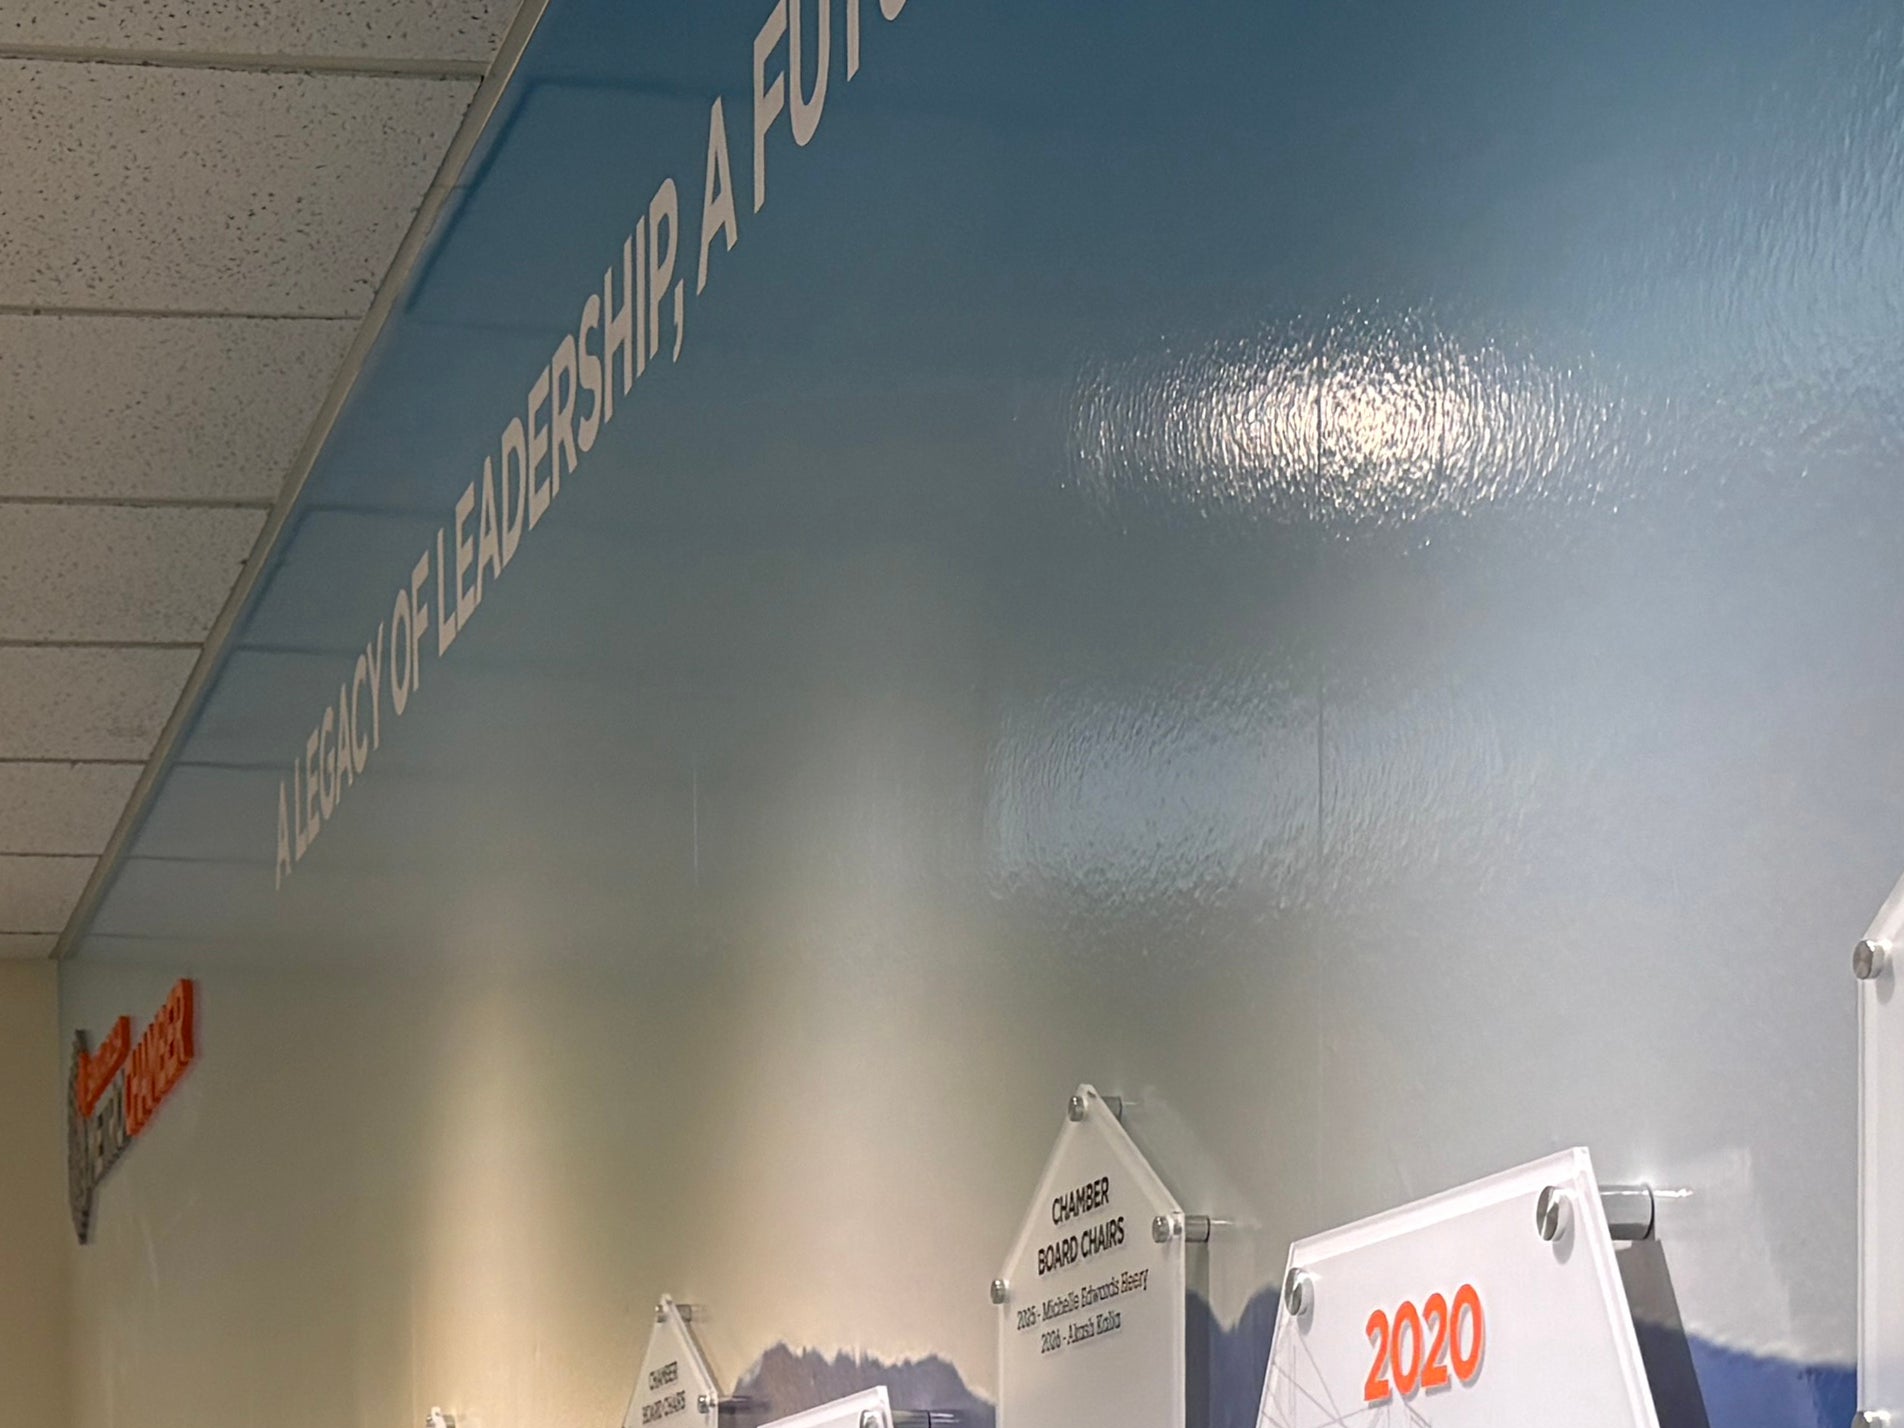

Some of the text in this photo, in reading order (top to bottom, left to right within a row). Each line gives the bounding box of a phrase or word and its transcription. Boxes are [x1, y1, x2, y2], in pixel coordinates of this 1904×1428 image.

[275, 0, 907, 891] A LEGACY OF LEADERSHIP, A FU
[1038, 1214, 1124, 1275] BOARD CHAIRS
[1052, 1175, 1109, 1226] CHAMBER
[1364, 1278, 1483, 1404] 2020
